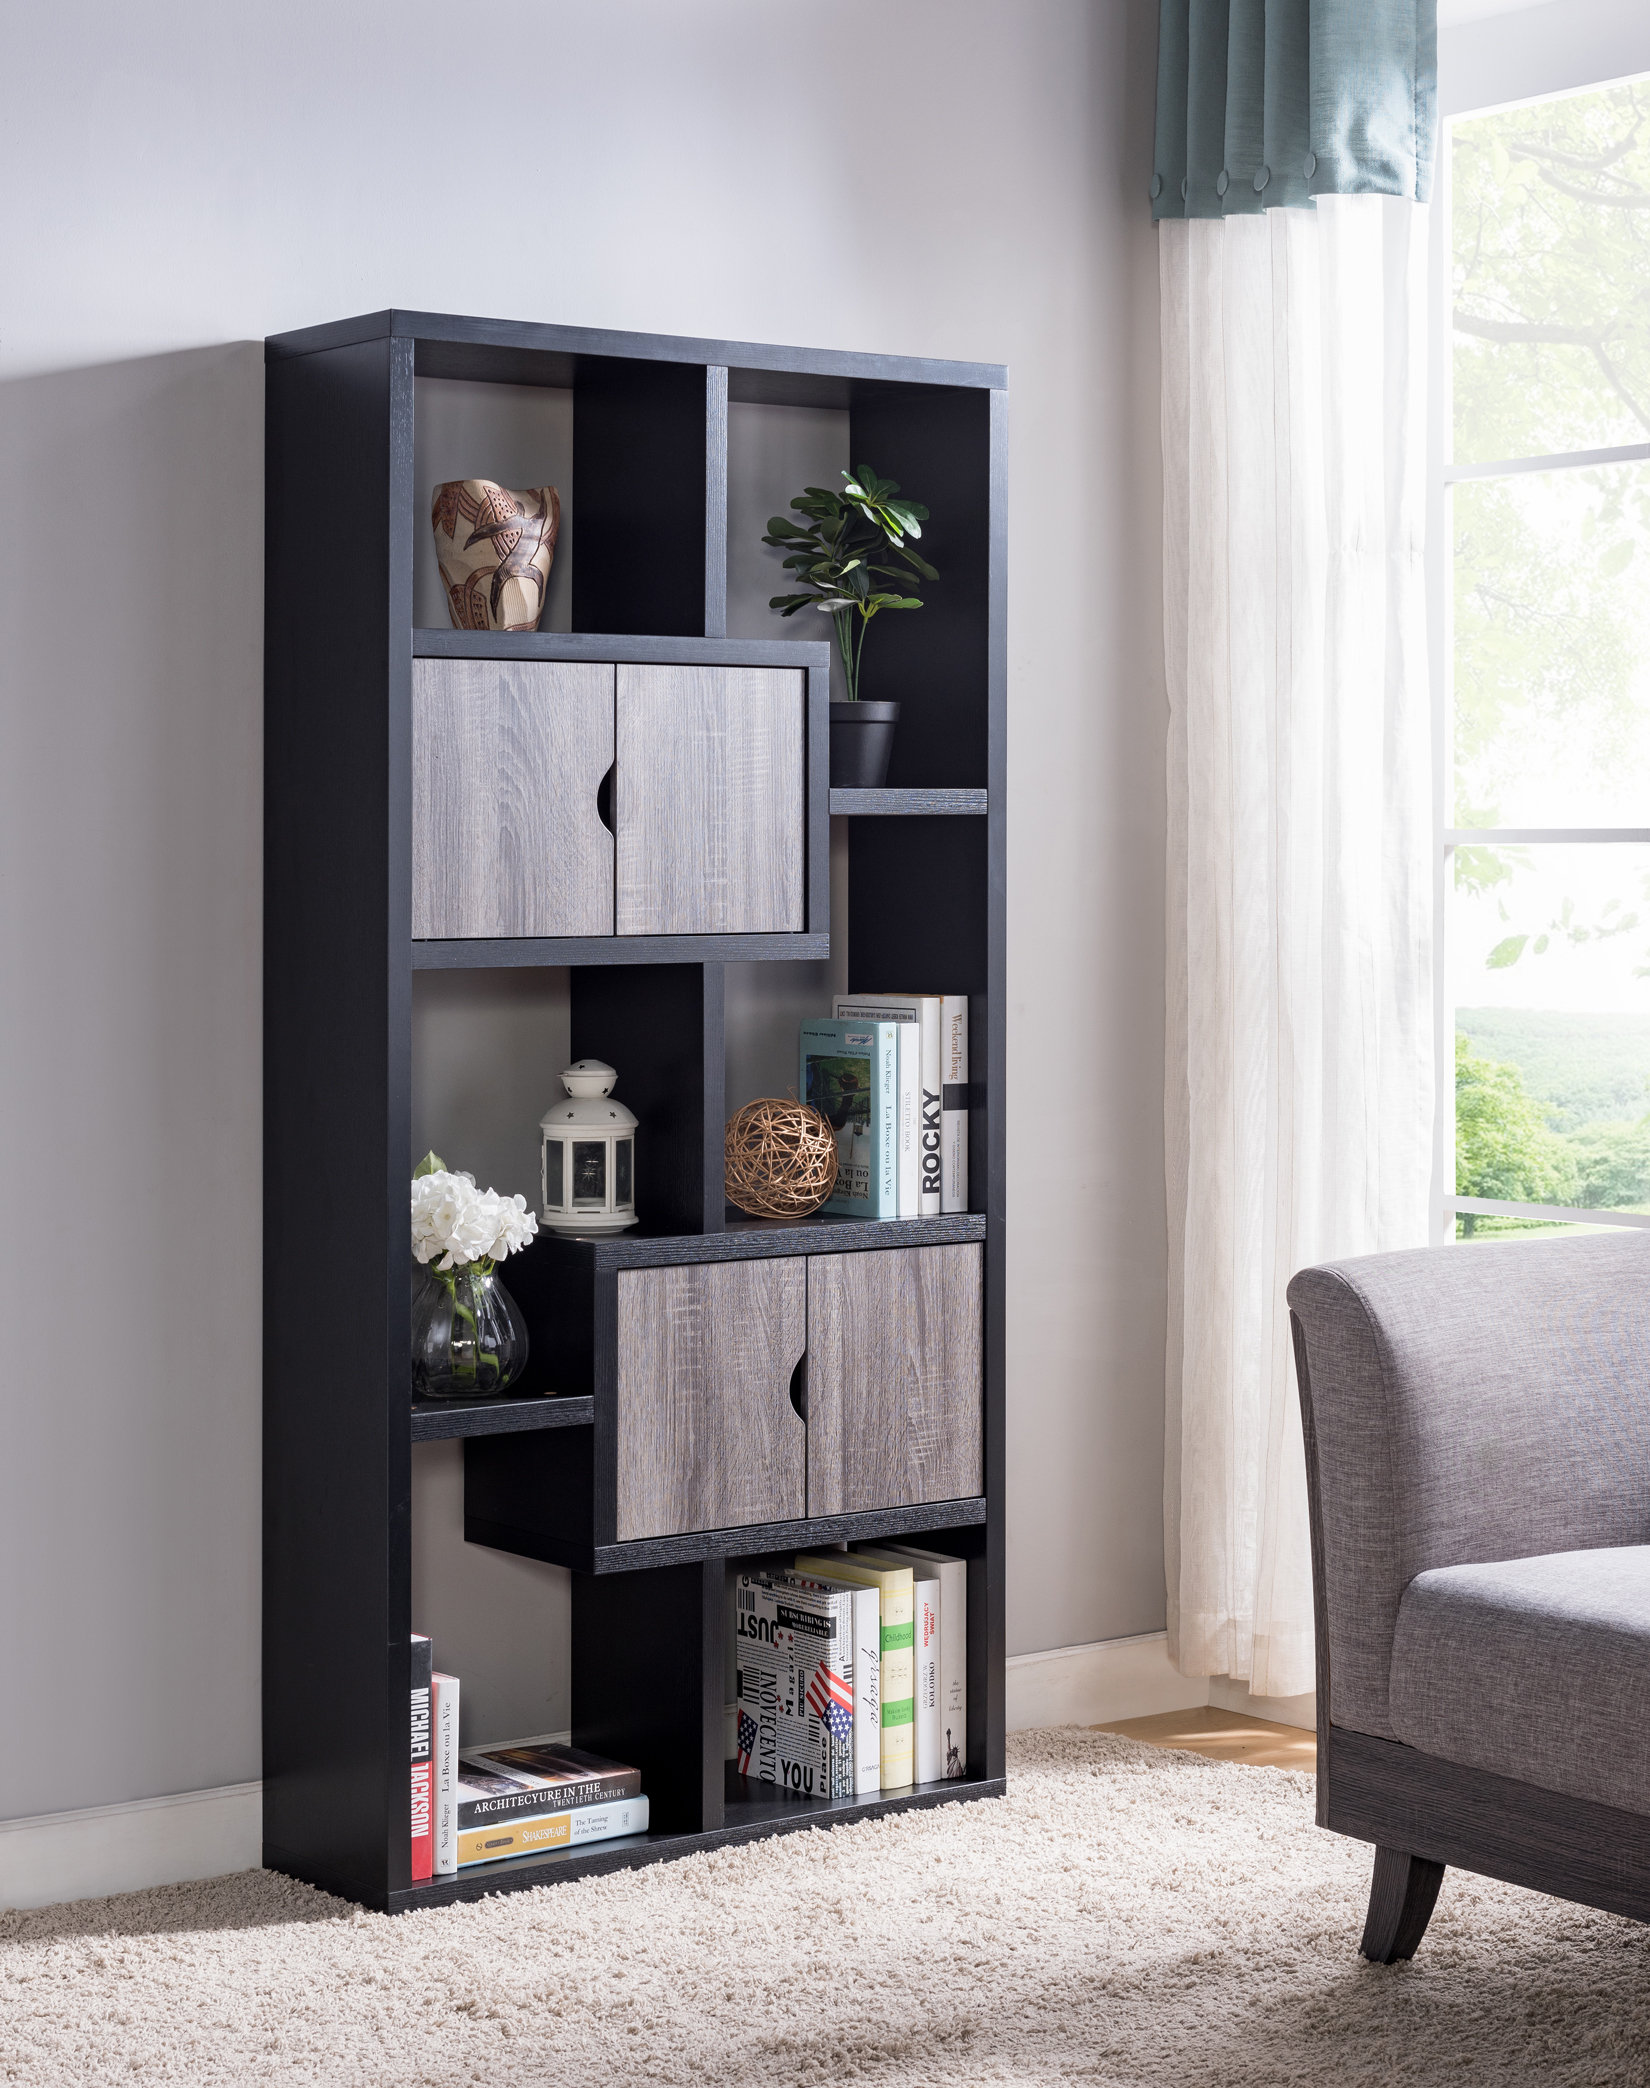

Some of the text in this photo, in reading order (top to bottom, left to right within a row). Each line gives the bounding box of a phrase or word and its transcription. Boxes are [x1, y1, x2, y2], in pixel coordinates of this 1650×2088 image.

[948, 1013, 962, 1080] Weekend living
[884, 1070, 892, 1094] Klieger
[885, 1106, 892, 1119] La
[922, 1088, 940, 1194] ROCKY
[885, 1150, 891, 1164] ou
[845, 1169, 853, 1178] la
[885, 1166, 892, 1176] la
[856, 1181, 868, 1191] La
[738, 1612, 779, 1643] JUST
[823, 1619, 831, 1628] IS
[885, 1628, 911, 1643] Childhood
[411, 1688, 430, 1762] MICHAEL
[760, 1671, 777, 1784] INOVECENTO
[441, 1702, 451, 1792] La Boxe ou la Vie
[781, 1759, 813, 1793] YOU
[411, 1763, 430, 1838] JACKSON
[474, 1782, 600, 1814] ARCHITECYURE IN THE
[594, 1788, 626, 1801] CENTURY
[441, 1804, 451, 1848] Noah Klieger
[587, 1816, 608, 1824] Taming
